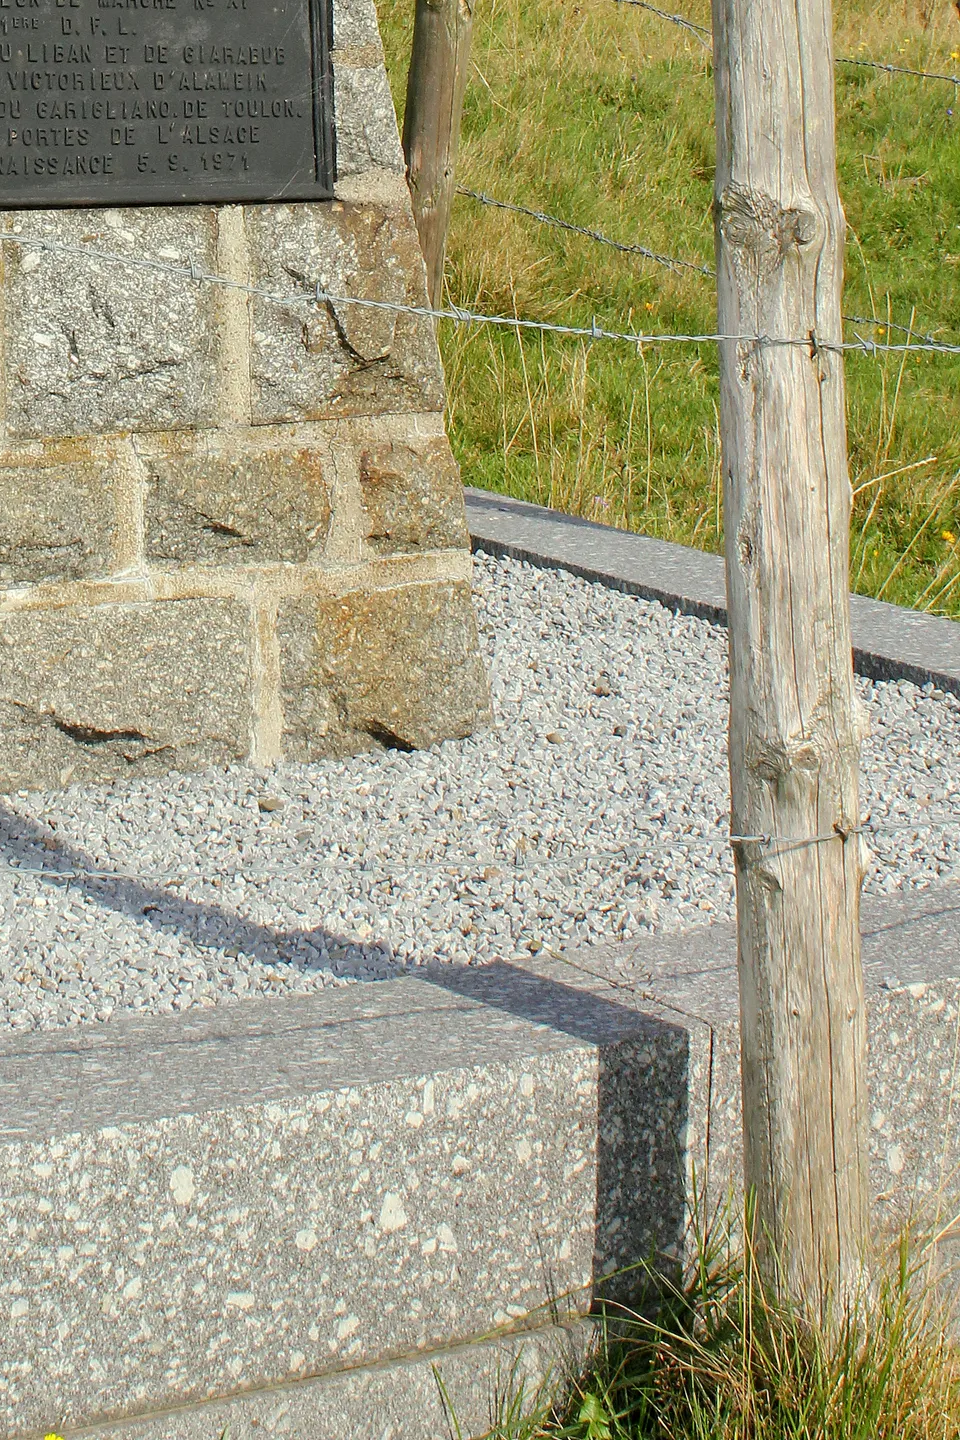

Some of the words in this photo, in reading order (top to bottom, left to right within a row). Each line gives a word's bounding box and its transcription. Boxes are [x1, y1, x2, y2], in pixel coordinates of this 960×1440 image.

[27, 43, 92, 64] LIBAN
[105, 45, 130, 64] ET
[144, 44, 168, 64] DE
[183, 45, 286, 66] GIARABUB
[7, 71, 140, 92] VICTORIEUX
[183, 99, 208, 120] DE
[8, 127, 89, 147] PORTES
[110, 126, 136, 147] DE
[158, 122, 260, 145] L'ALSACE
